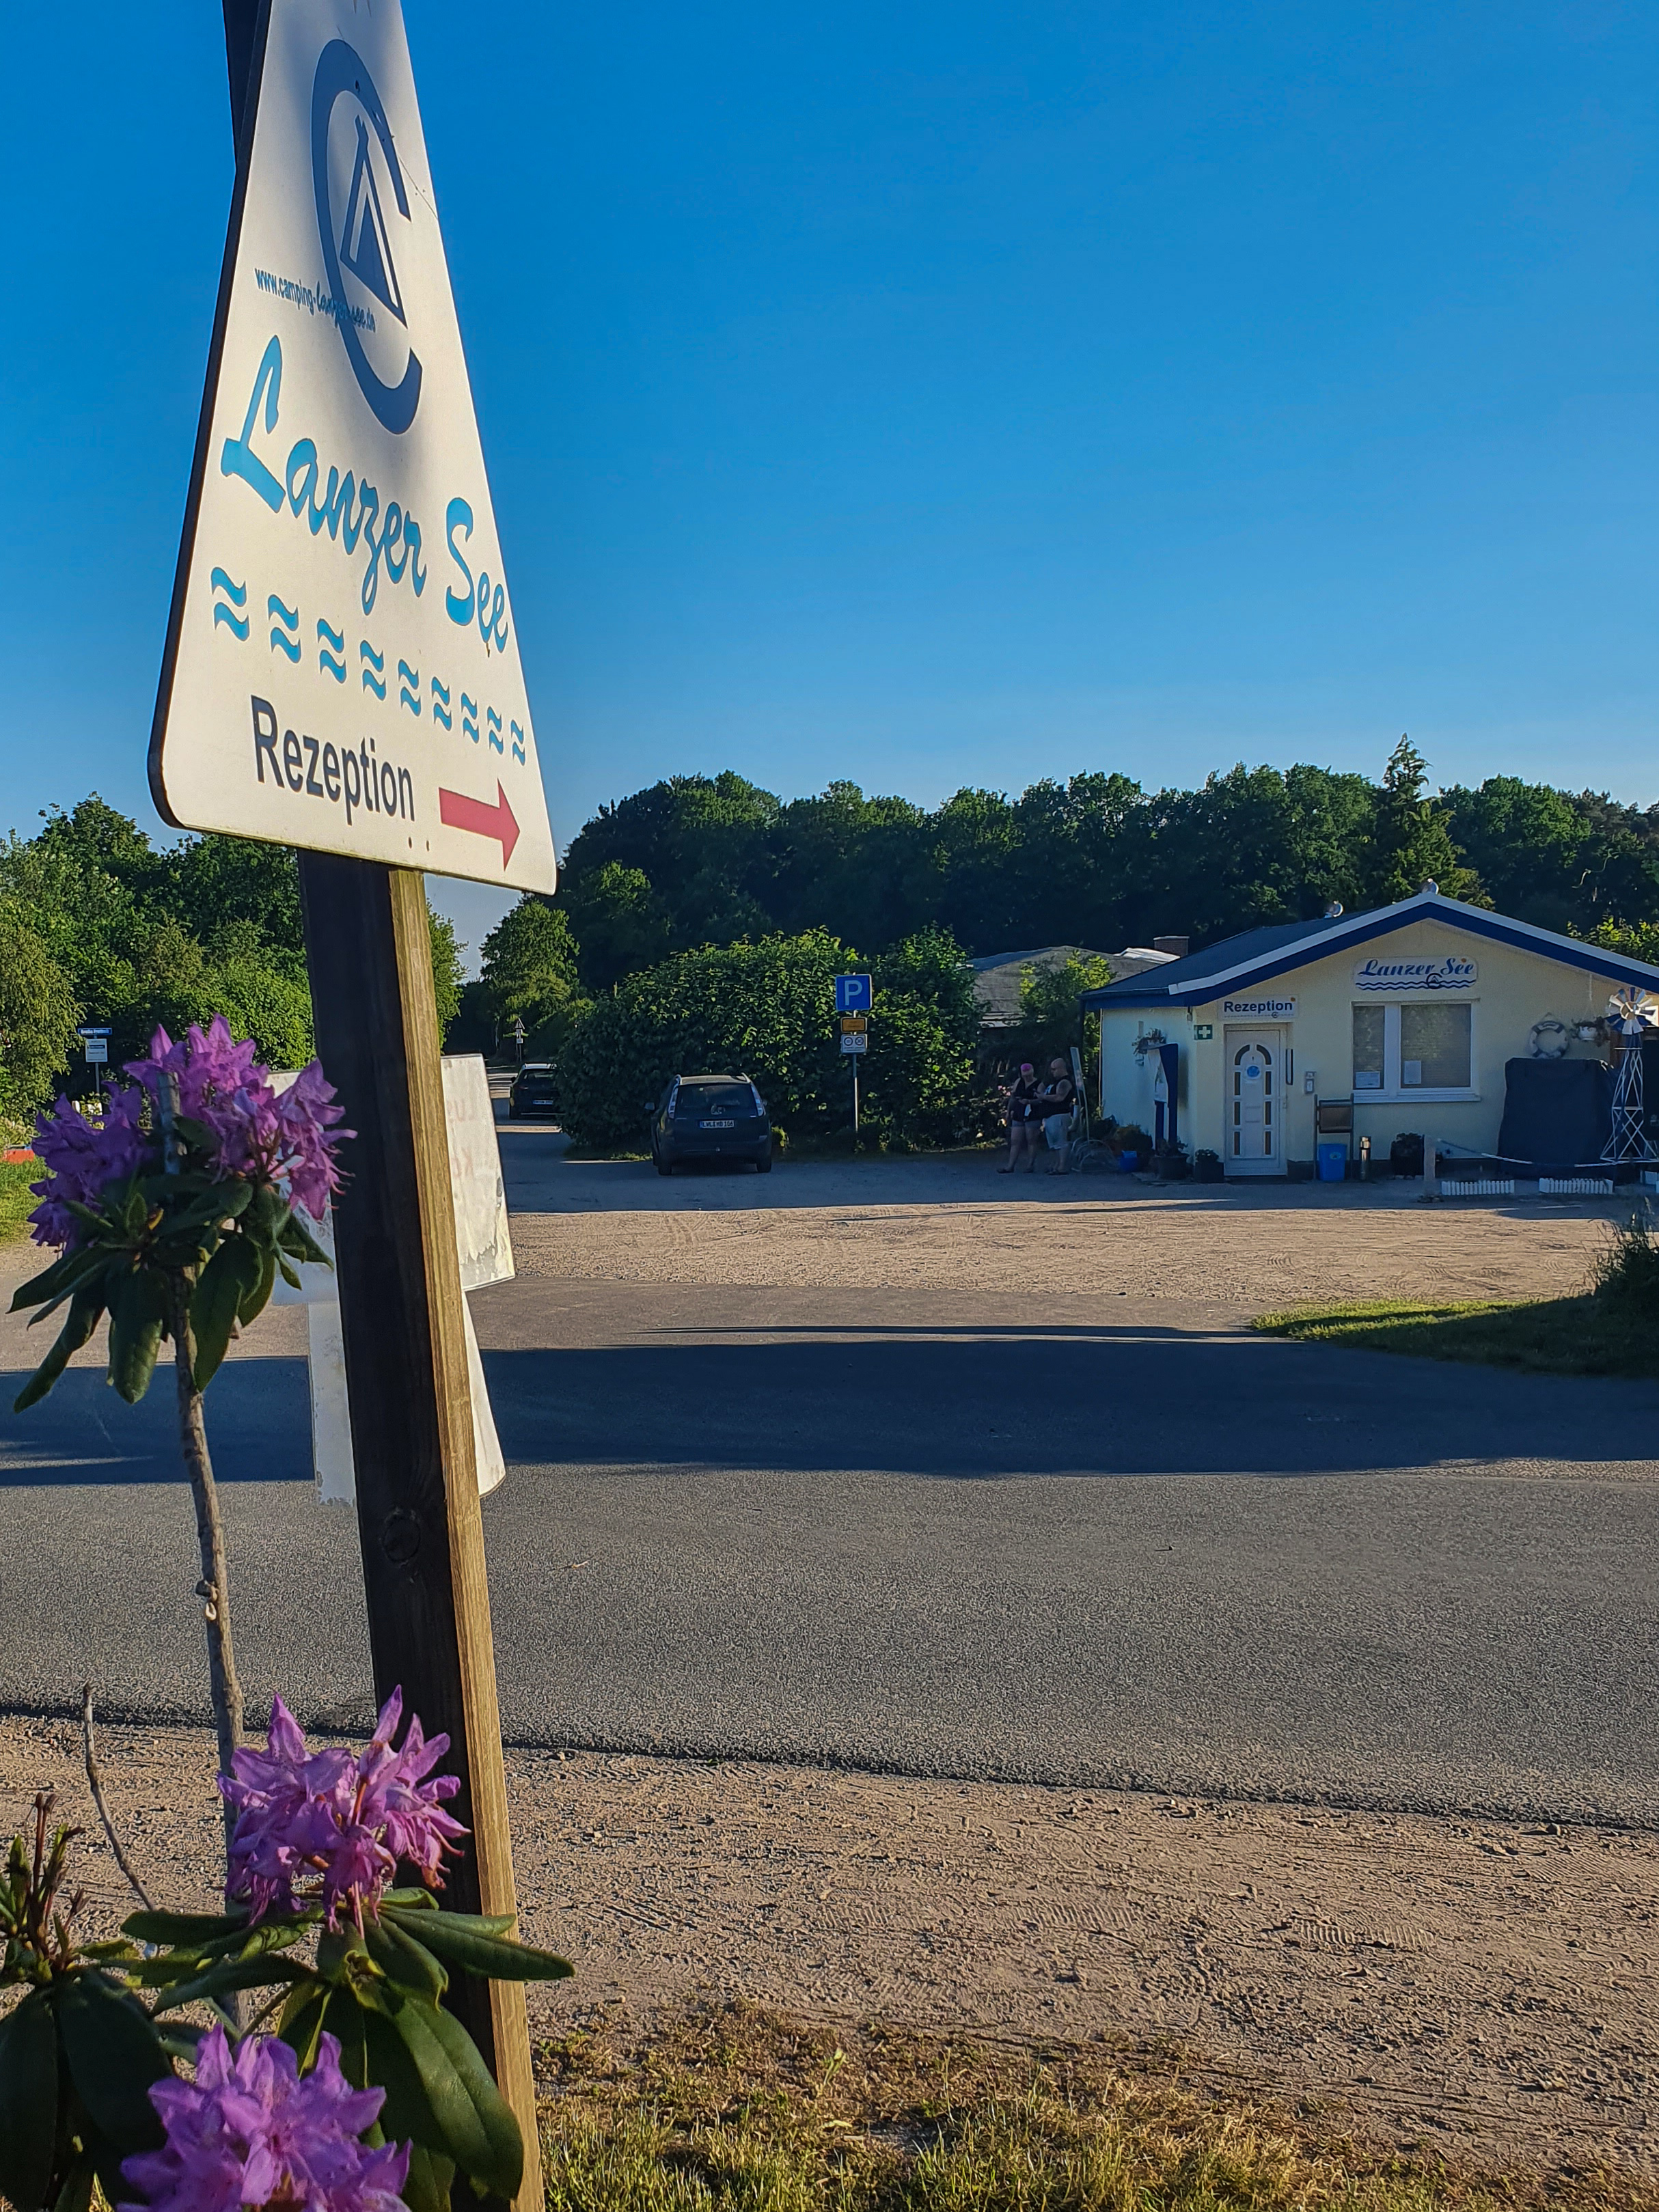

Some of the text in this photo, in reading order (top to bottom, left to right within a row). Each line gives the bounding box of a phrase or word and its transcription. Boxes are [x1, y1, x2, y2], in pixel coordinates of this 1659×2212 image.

[221, 335, 508, 654] Lanzer See
[251, 694, 415, 826] Rezeption
[1358, 958, 1475, 976] Lanzer See
[845, 980, 863, 1006] P
[1224, 1000, 1293, 1014] Rezeption
